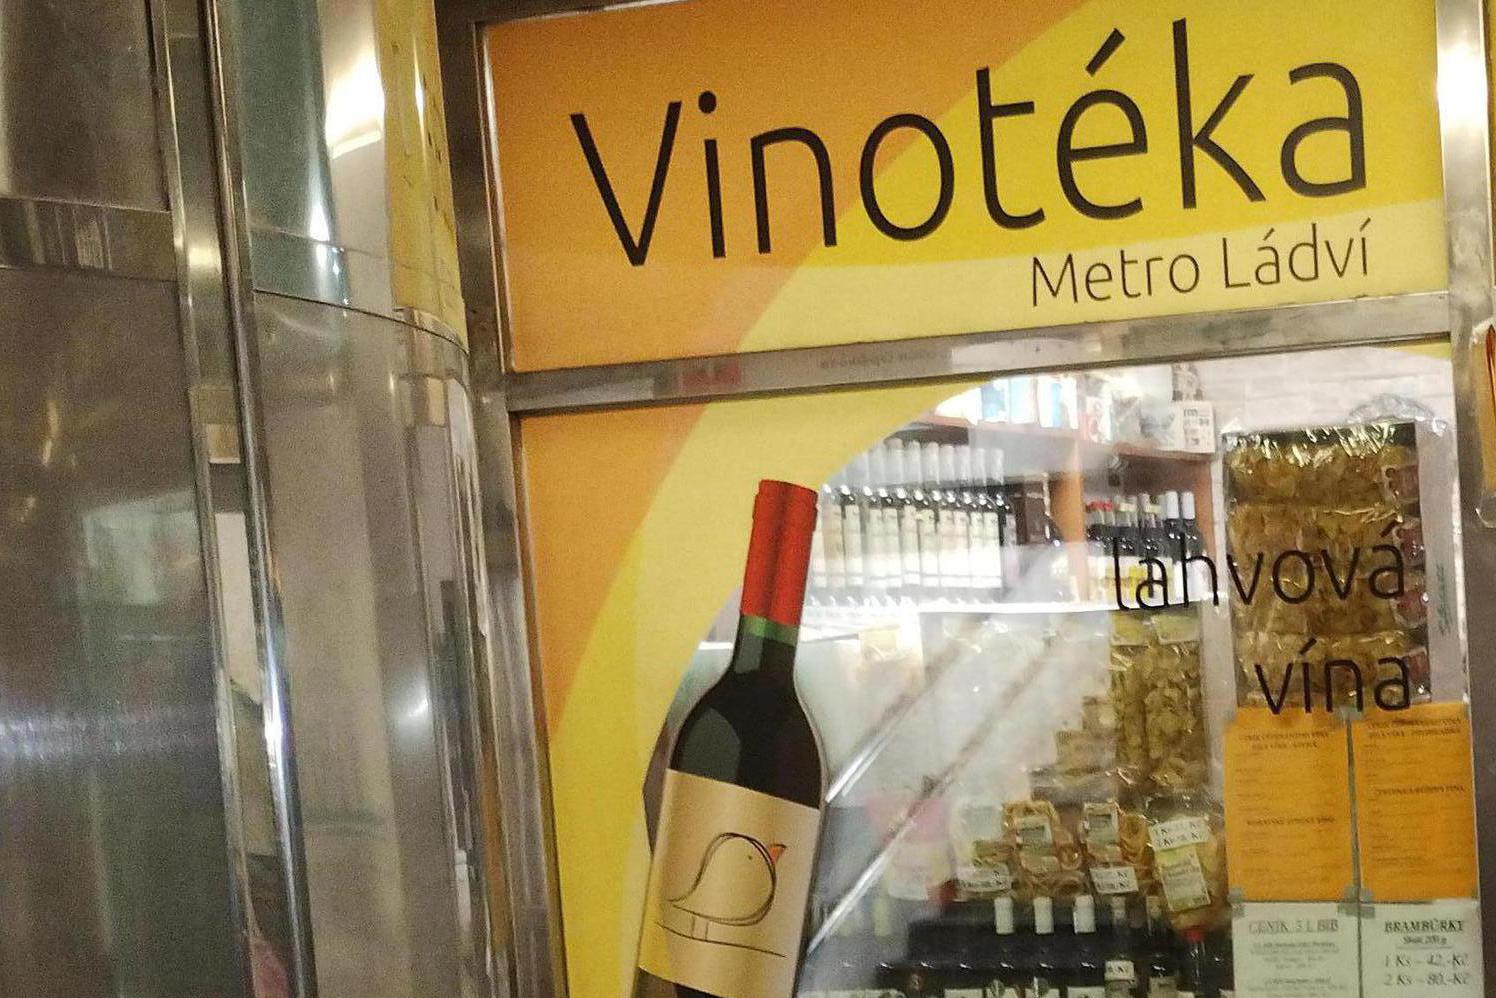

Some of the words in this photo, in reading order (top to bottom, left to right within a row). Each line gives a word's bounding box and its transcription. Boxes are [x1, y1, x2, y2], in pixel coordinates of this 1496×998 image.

[570, 17, 1368, 267] Vinotéka
[1031, 247, 1201, 307] Metro
[1221, 218, 1374, 291] Ládví
[1113, 520, 1406, 612] lahvová
[1255, 637, 1411, 715] vína
